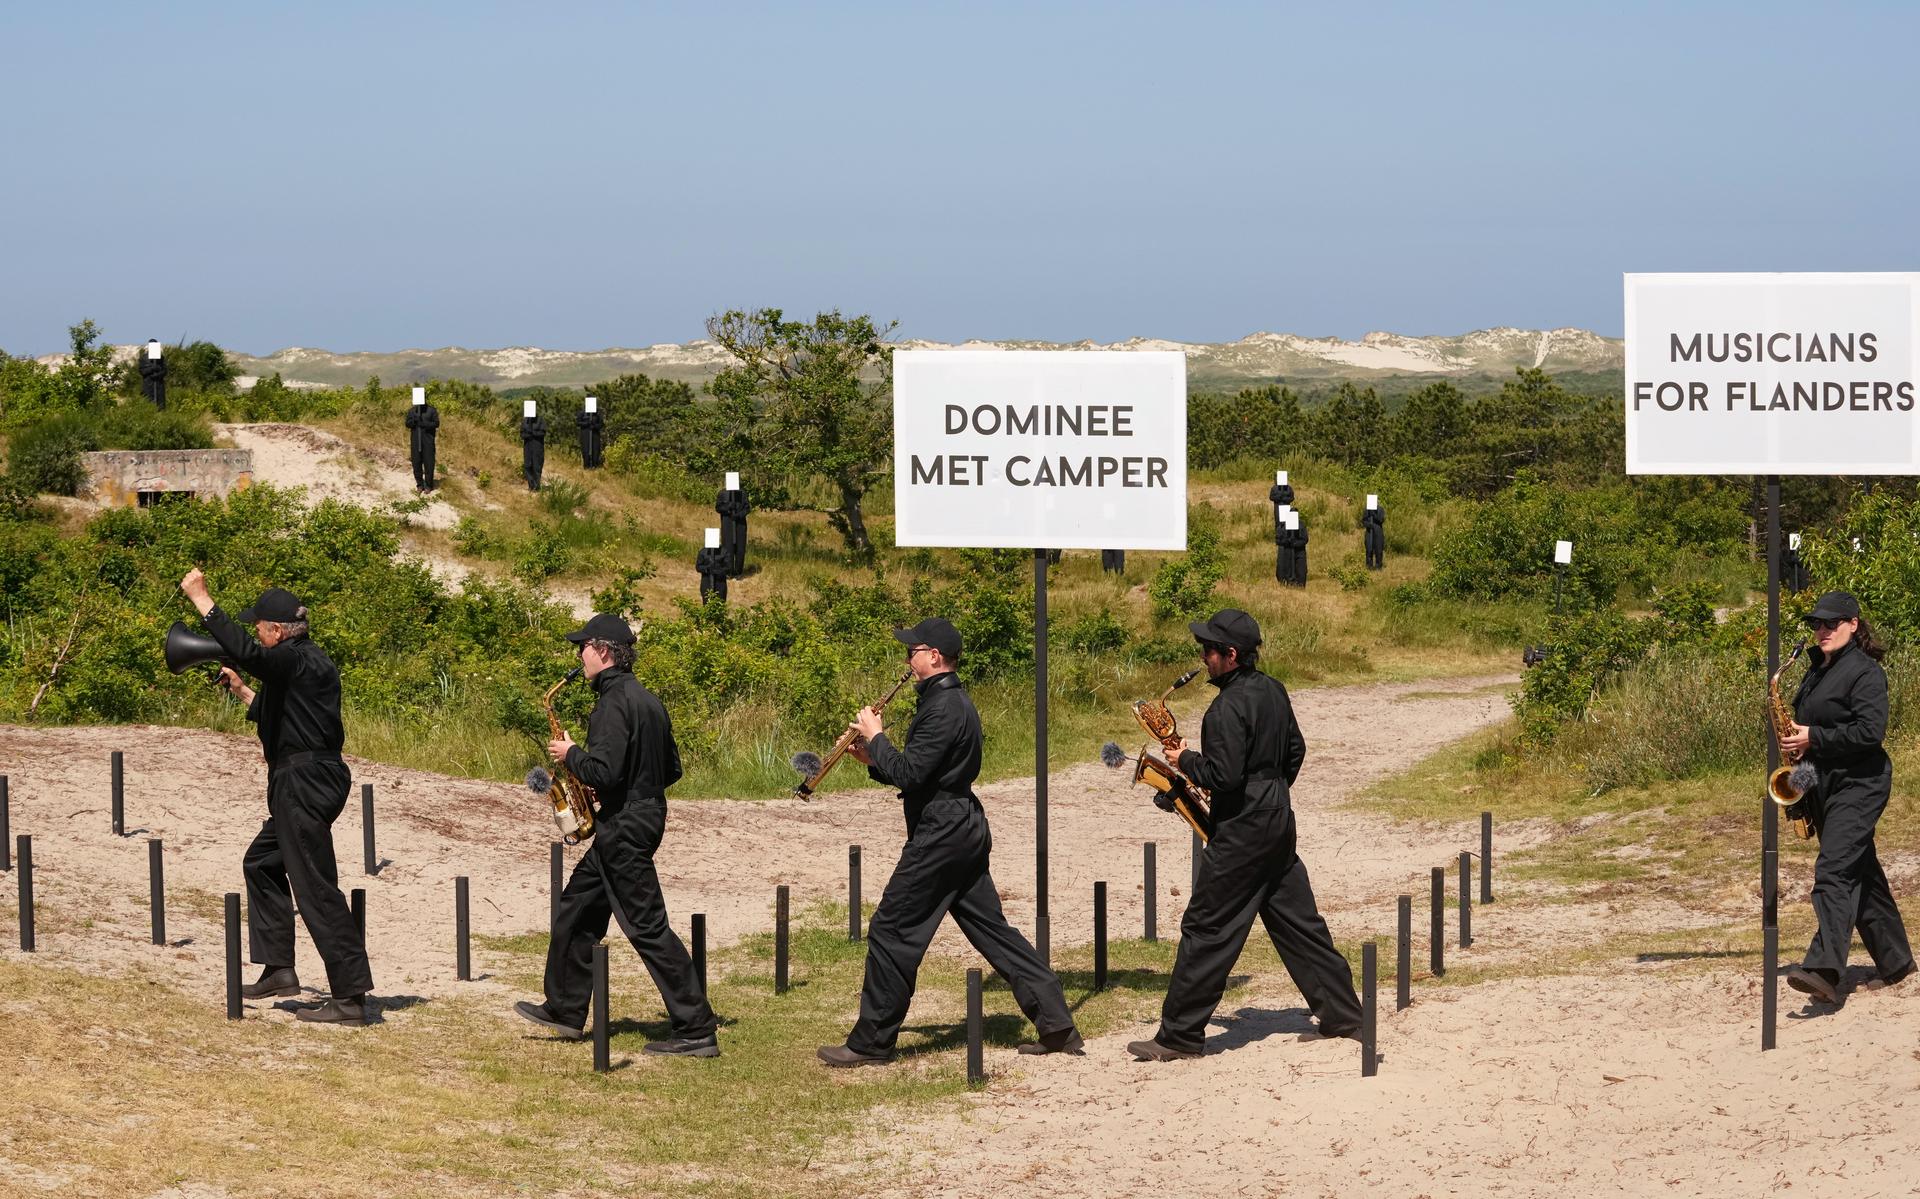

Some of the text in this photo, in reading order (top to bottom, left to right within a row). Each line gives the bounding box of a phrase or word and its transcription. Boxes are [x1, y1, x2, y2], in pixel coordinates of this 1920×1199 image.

[1670, 332, 1878, 363] MUSICIANS
[1633, 381, 1915, 412] FOR FLANDERS
[945, 404, 1134, 437] DOMINEE
[911, 454, 1168, 488] MET CAMPER
